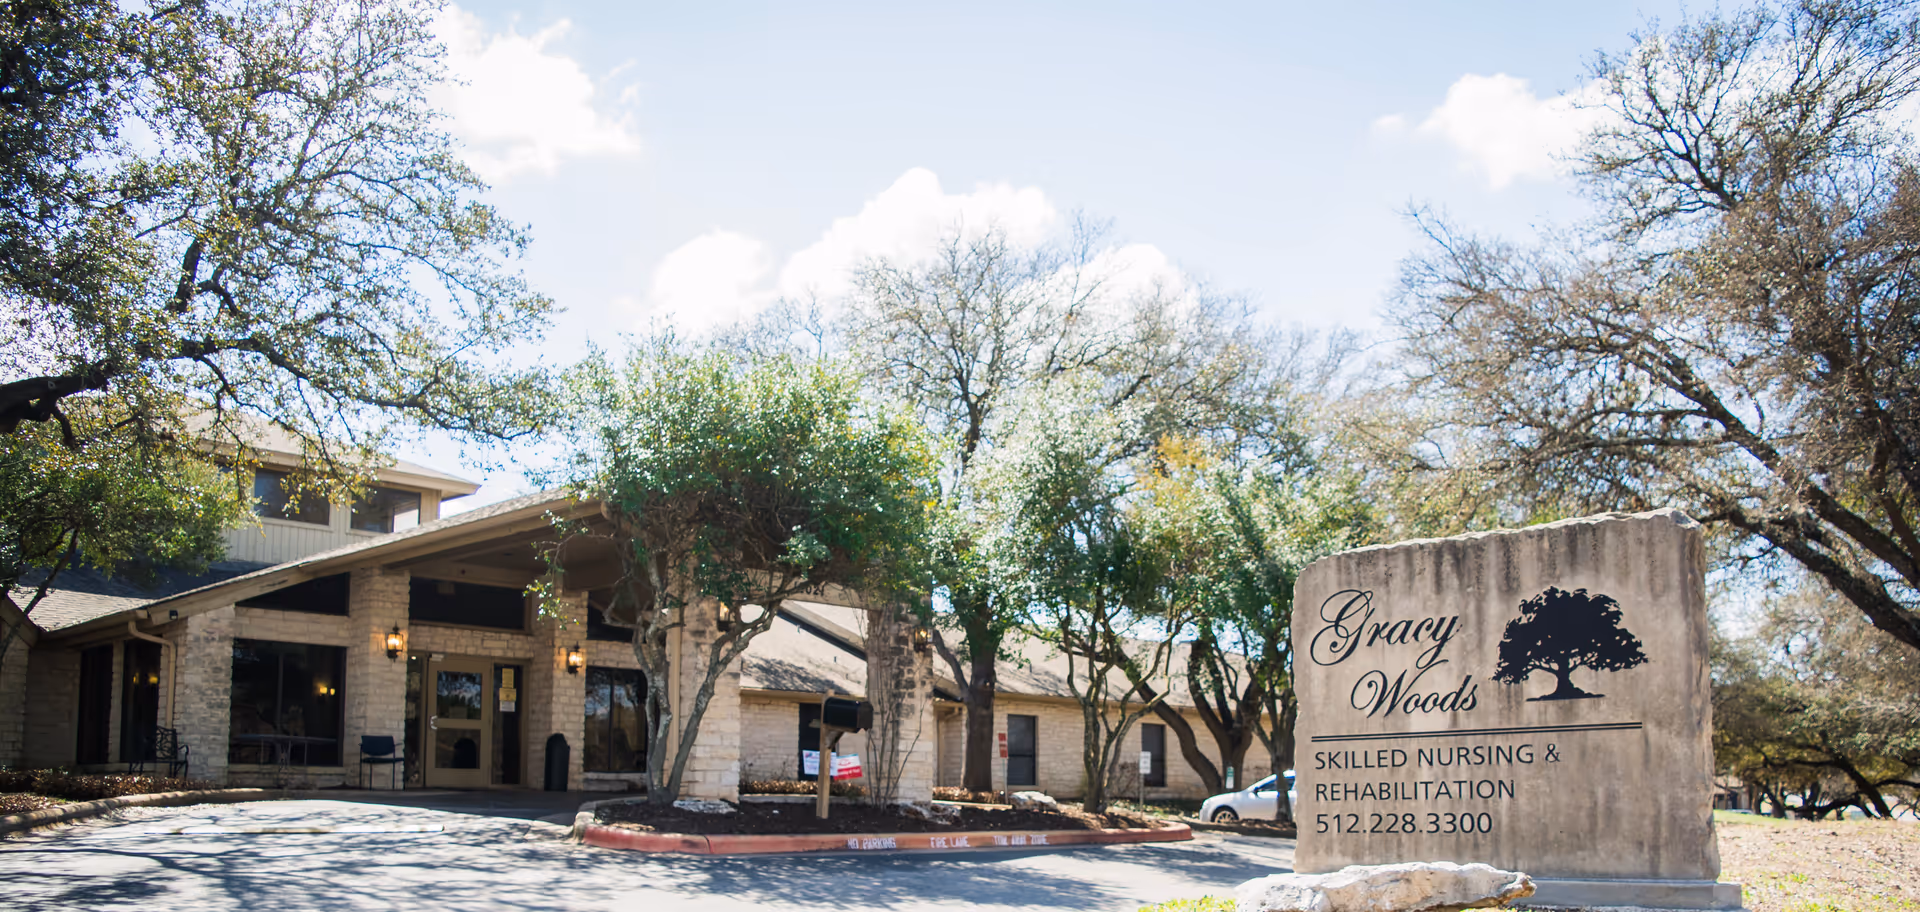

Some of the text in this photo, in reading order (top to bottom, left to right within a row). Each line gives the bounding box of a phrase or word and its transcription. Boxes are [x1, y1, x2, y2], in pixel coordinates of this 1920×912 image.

[1310, 589, 1462, 669] Gracy
[1350, 659, 1477, 718] Woods
[1315, 743, 1561, 770] SKILLED NURSING &
[1315, 779, 1515, 801] REHABILITATION
[1316, 812, 1493, 834] 512.228.3300
[847, 836, 897, 850] NO PARKING
[930, 836, 971, 848] FIRE LANE
[1030, 834, 1050, 845] ZONE
